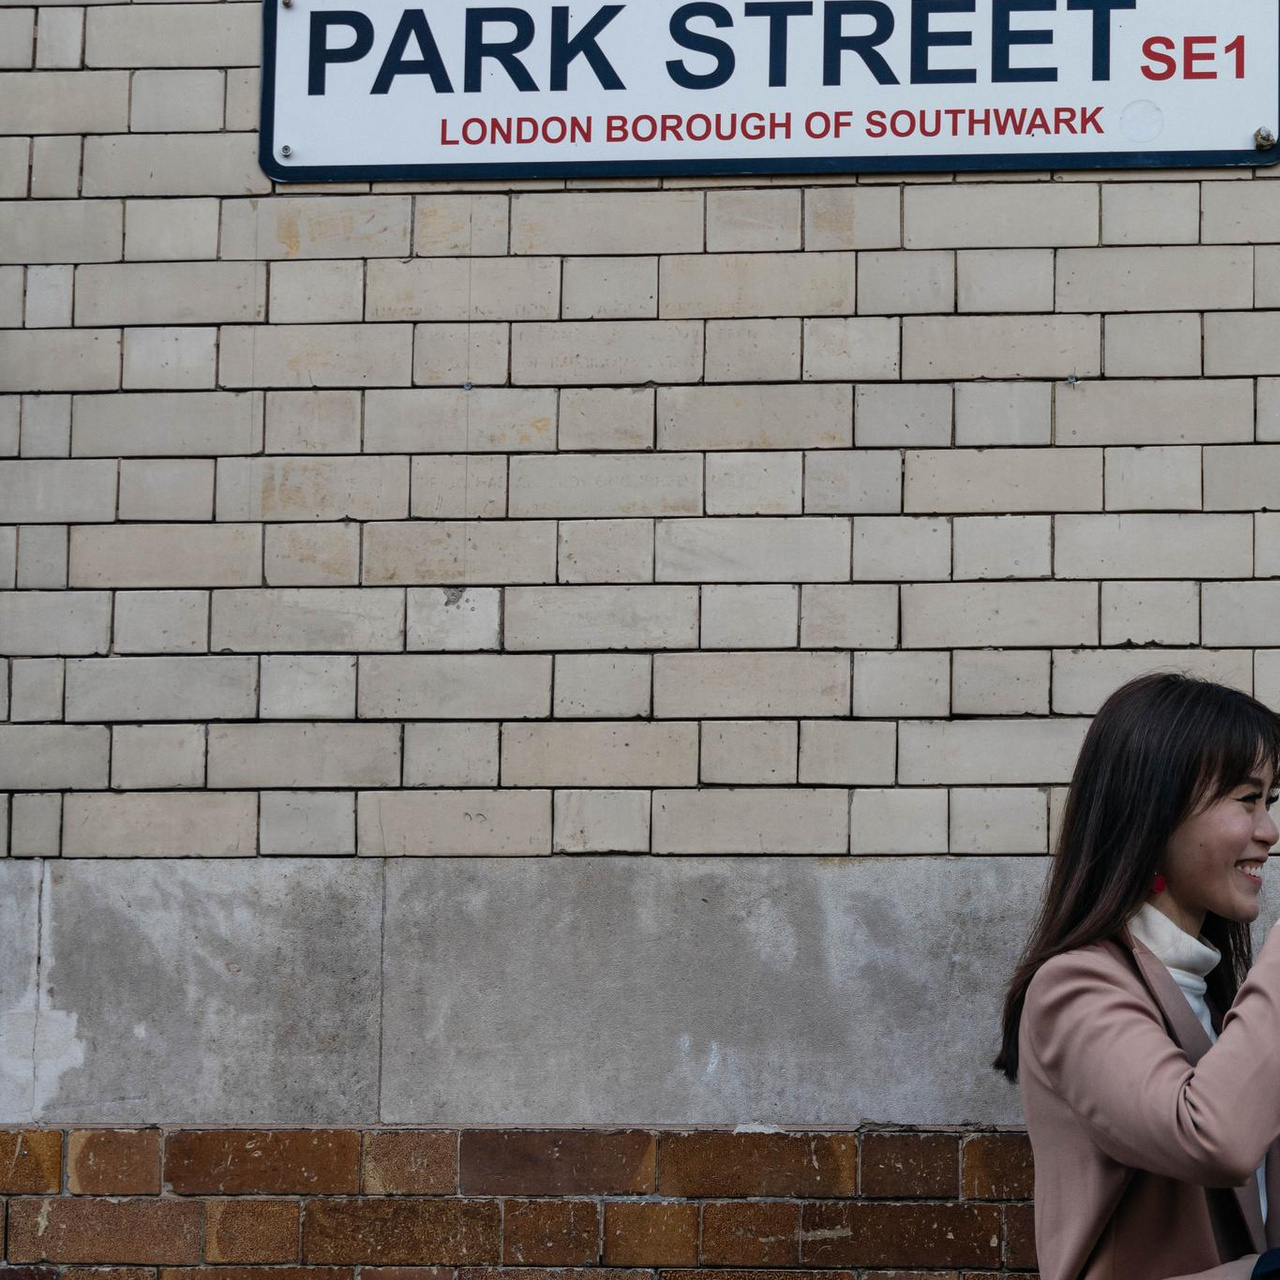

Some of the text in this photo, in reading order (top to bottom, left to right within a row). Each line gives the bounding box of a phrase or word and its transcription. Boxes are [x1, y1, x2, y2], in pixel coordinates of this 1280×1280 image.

[307, 4, 627, 96] PARK
[1141, 35, 1248, 81] SE1
[440, 107, 1105, 146] LONDON BOROUGH OF SOUTHWARK
